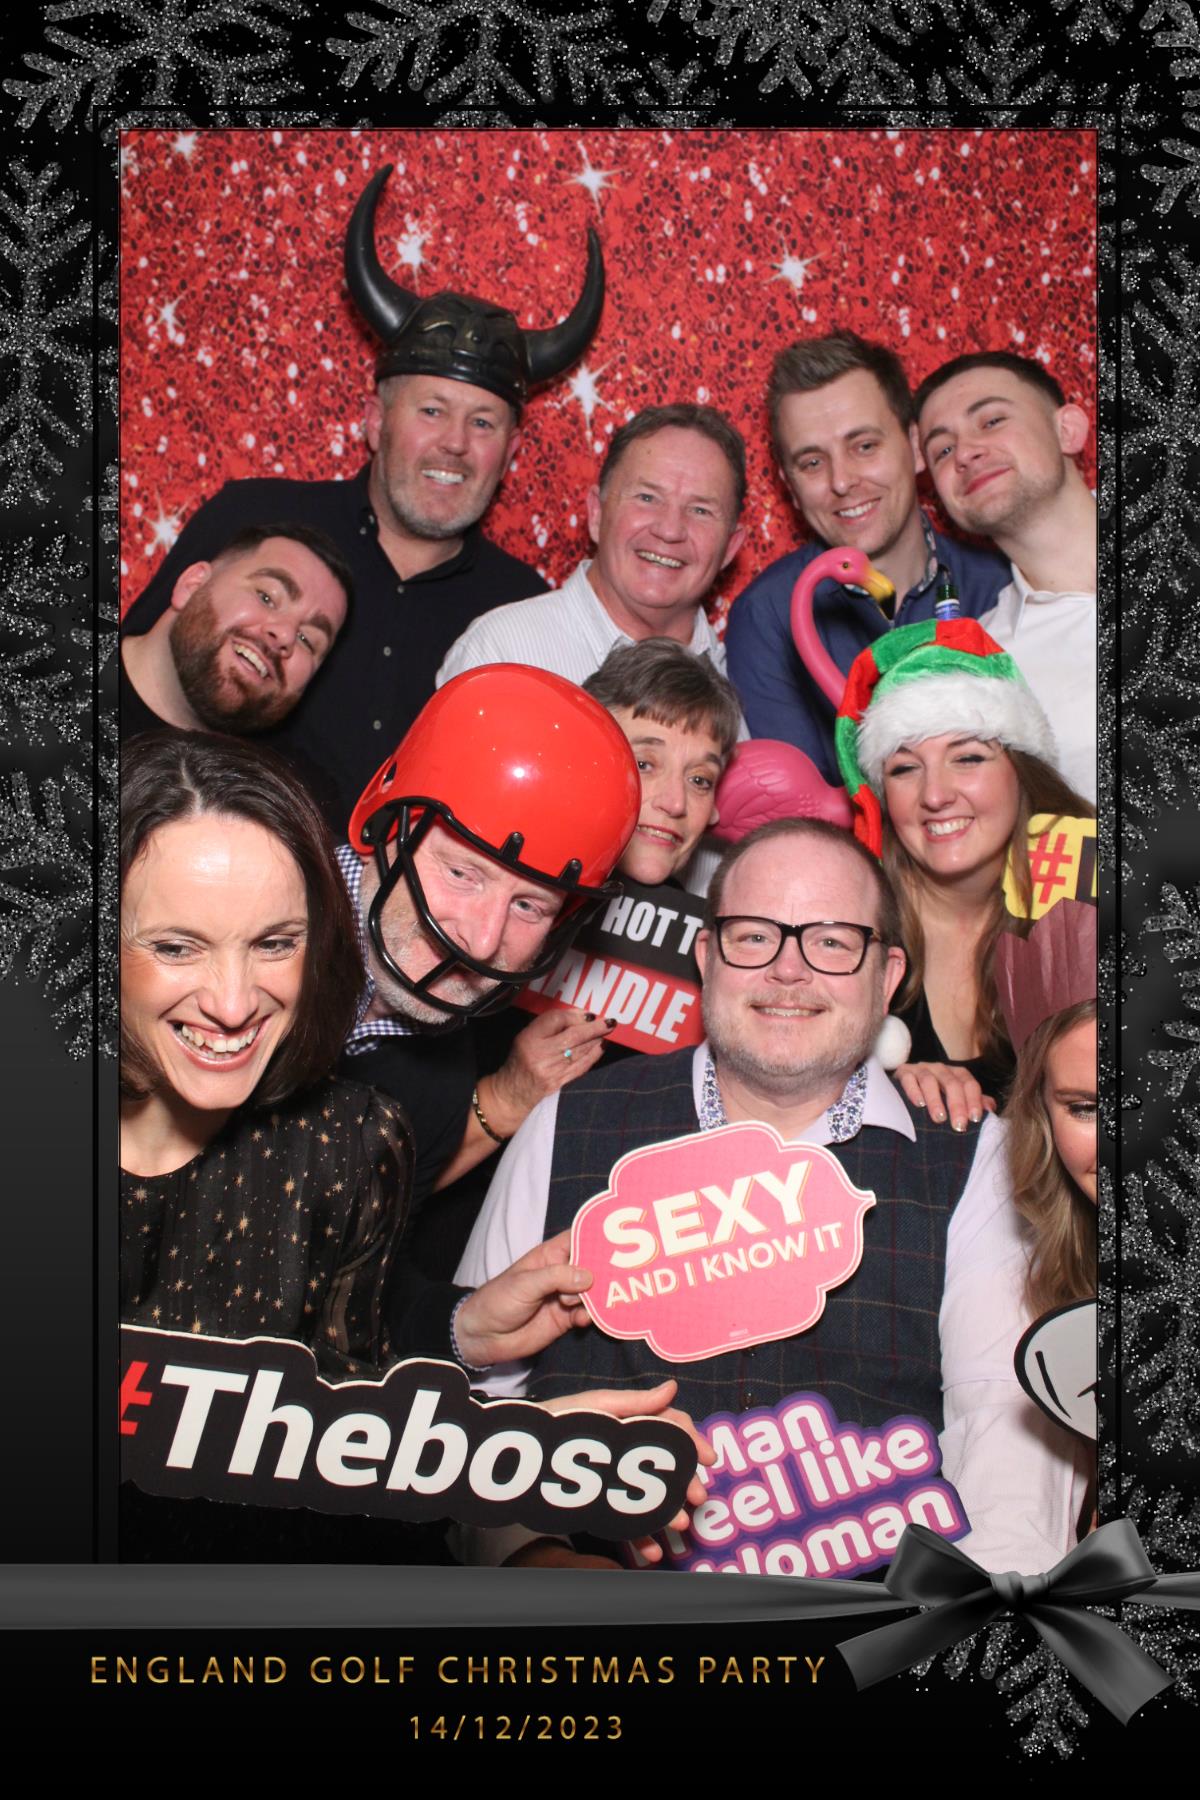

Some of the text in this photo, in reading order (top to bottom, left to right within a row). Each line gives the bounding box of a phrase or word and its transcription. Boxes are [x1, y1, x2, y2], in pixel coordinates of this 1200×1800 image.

[600, 896, 704, 956] HOT T
[528, 948, 696, 1043] ANDLE
[602, 1159, 812, 1269] SEXY
[606, 1222, 843, 1308] AND I KNOW IT
[697, 1404, 829, 1485] Man
[800, 1428, 930, 1502] like
